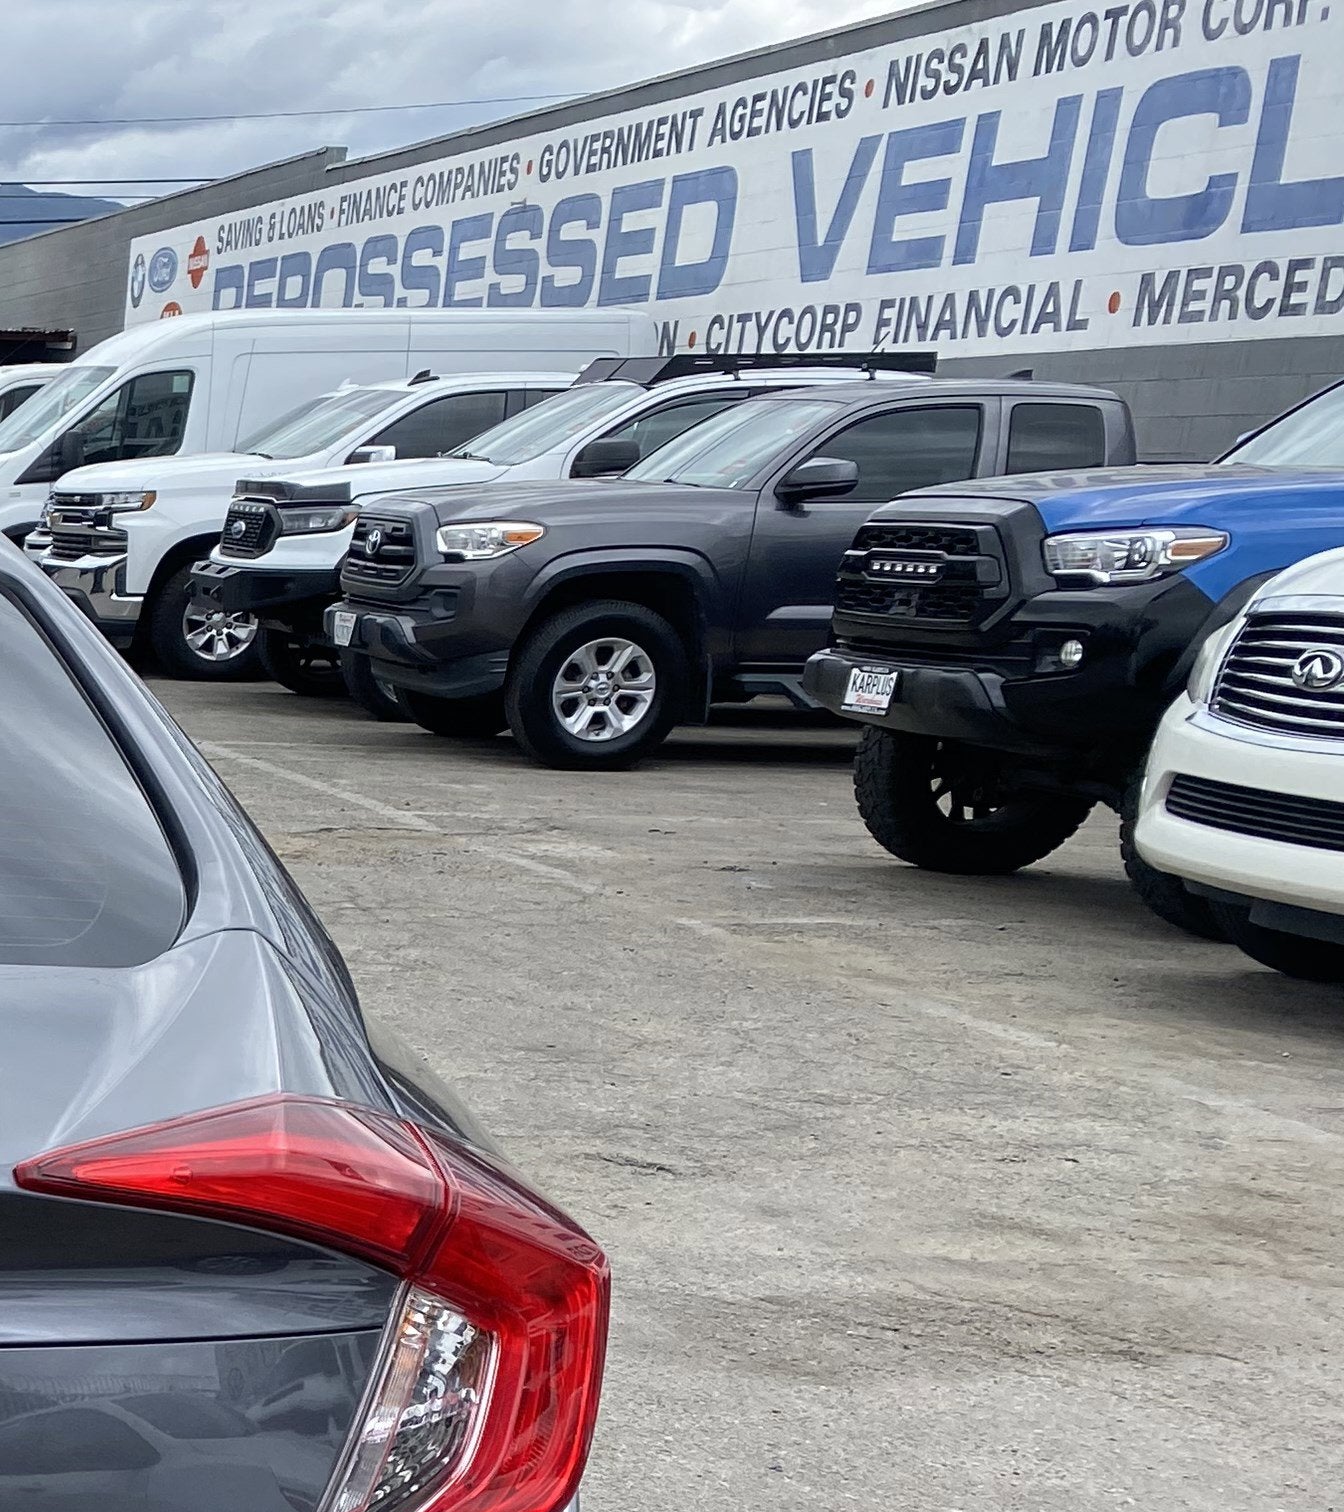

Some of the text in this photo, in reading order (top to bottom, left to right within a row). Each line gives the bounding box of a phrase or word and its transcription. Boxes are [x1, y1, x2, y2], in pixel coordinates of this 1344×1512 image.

[217, 216, 262, 254] SAVING
[267, 218, 277, 242] &
[278, 201, 325, 240] LOANS
[337, 180, 408, 227] FINANCE
[412, 152, 520, 211] COMPANIES
[538, 107, 704, 183] GOVERNMENT
[707, 69, 856, 148] AGENCIES
[882, 28, 1026, 109] NISSAN
[1032, 0, 1183, 77] MOTOR
[791, 54, 1344, 283] VEHICL
[706, 302, 863, 355] CITYCORP
[874, 279, 1090, 345] FINANCIAL
[850, 672, 894, 697] KARPLUS
